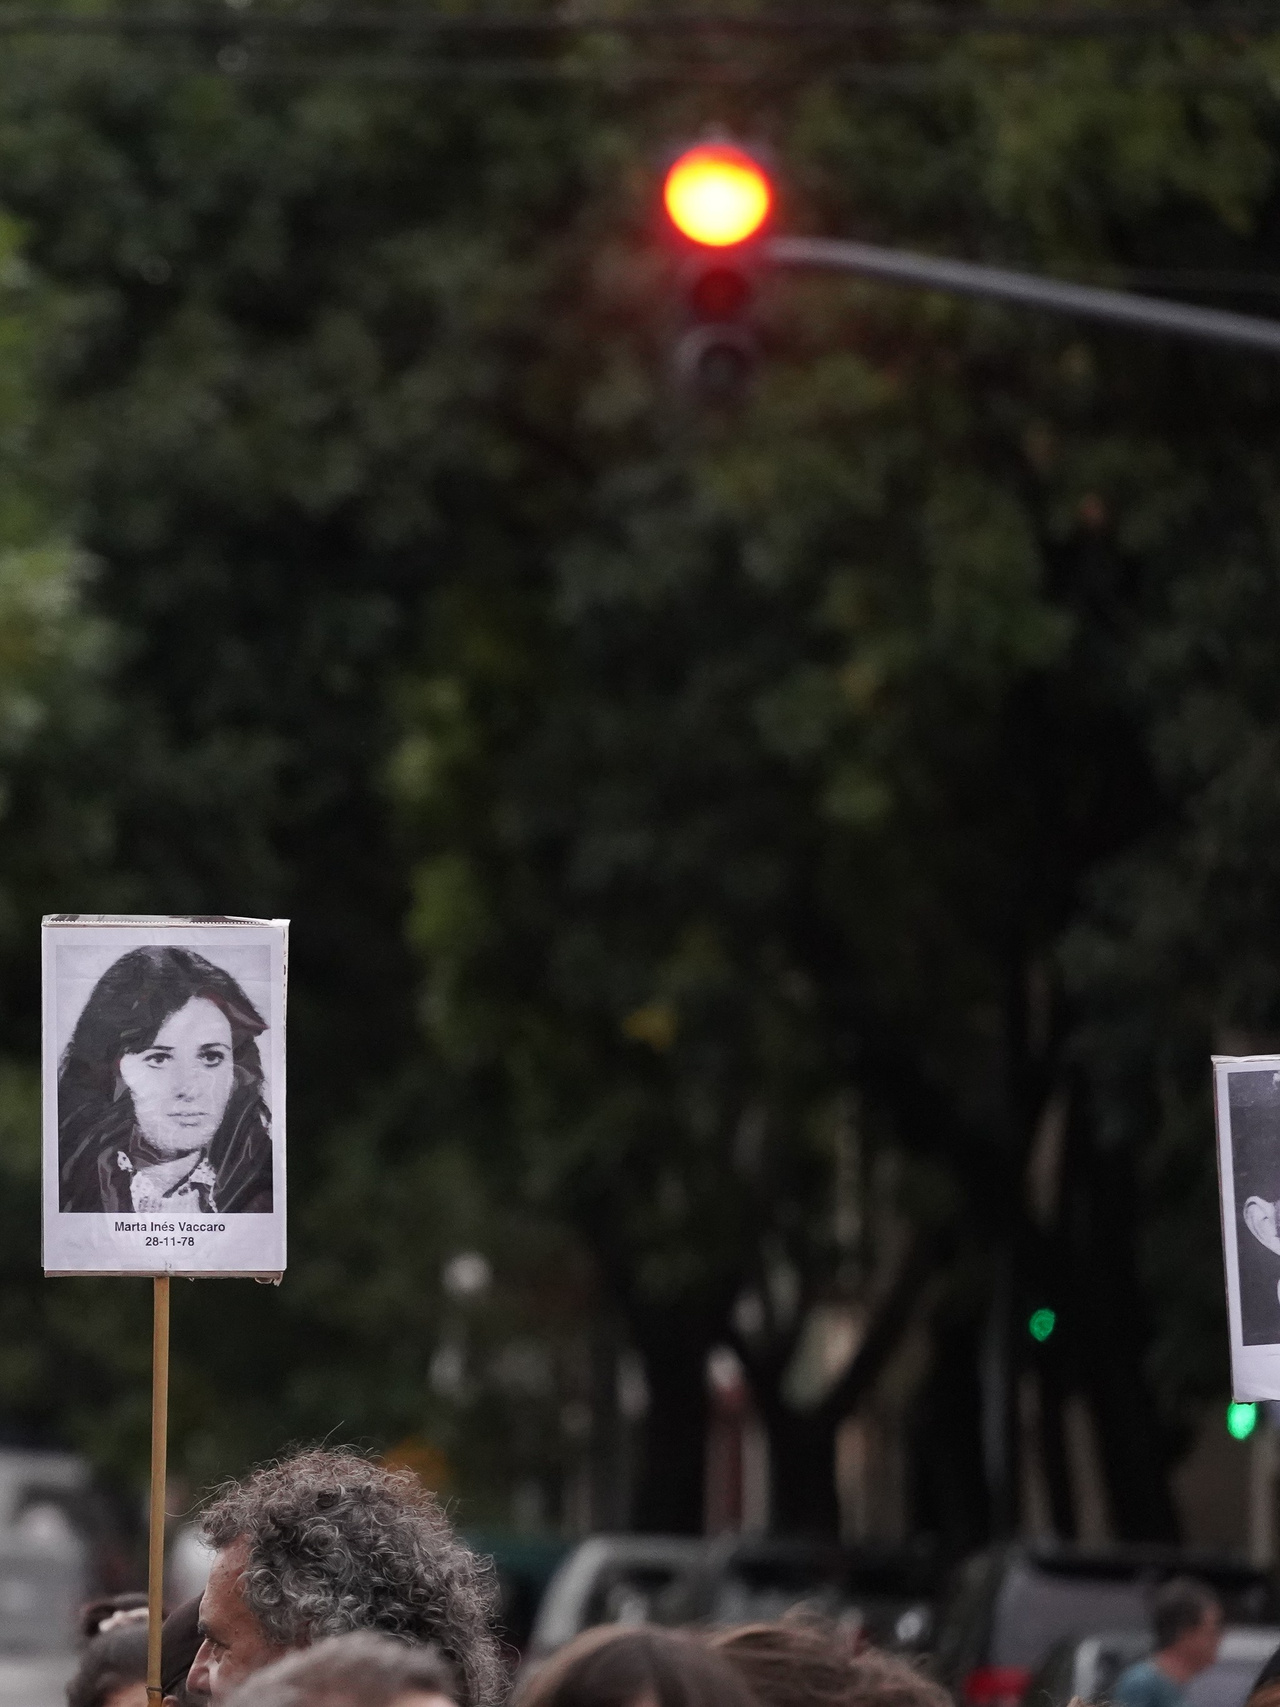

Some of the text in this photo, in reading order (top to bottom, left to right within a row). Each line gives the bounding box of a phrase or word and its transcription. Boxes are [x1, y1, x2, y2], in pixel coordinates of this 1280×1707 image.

[115, 1221, 226, 1232] Marta Inés Vaccaro
[145, 1236, 195, 1247] 28-11-78
